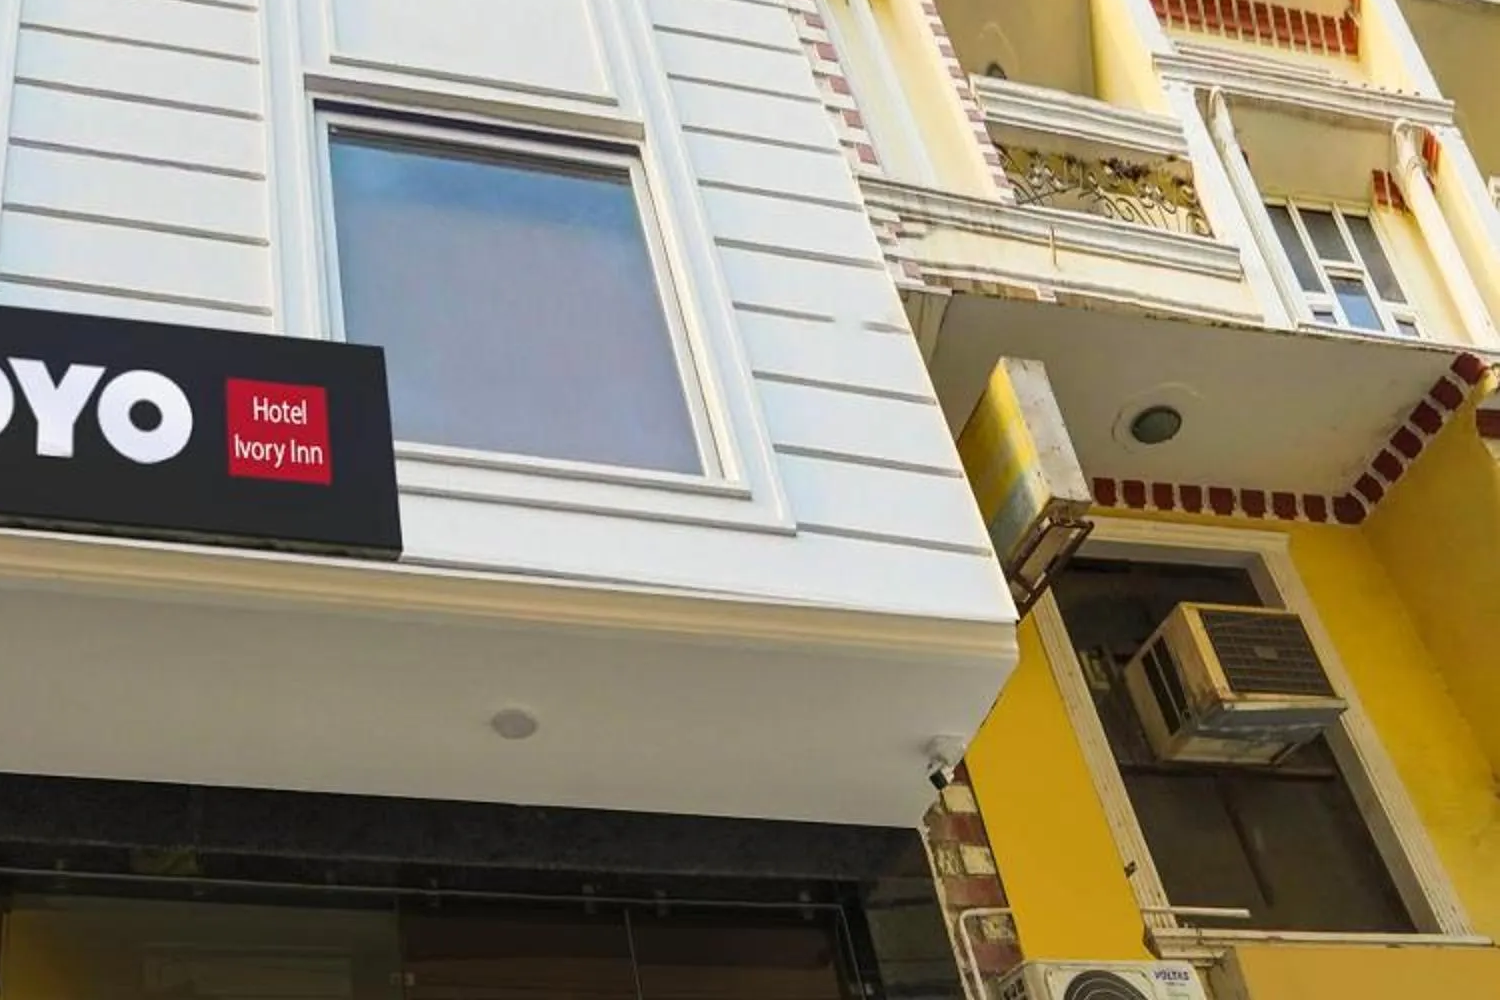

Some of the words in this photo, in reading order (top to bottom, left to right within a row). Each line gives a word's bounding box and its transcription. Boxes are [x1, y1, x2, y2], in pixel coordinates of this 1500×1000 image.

[253, 396, 307, 425] Hotel
[234, 433, 286, 469] Ivory
[290, 439, 323, 465] Inn
